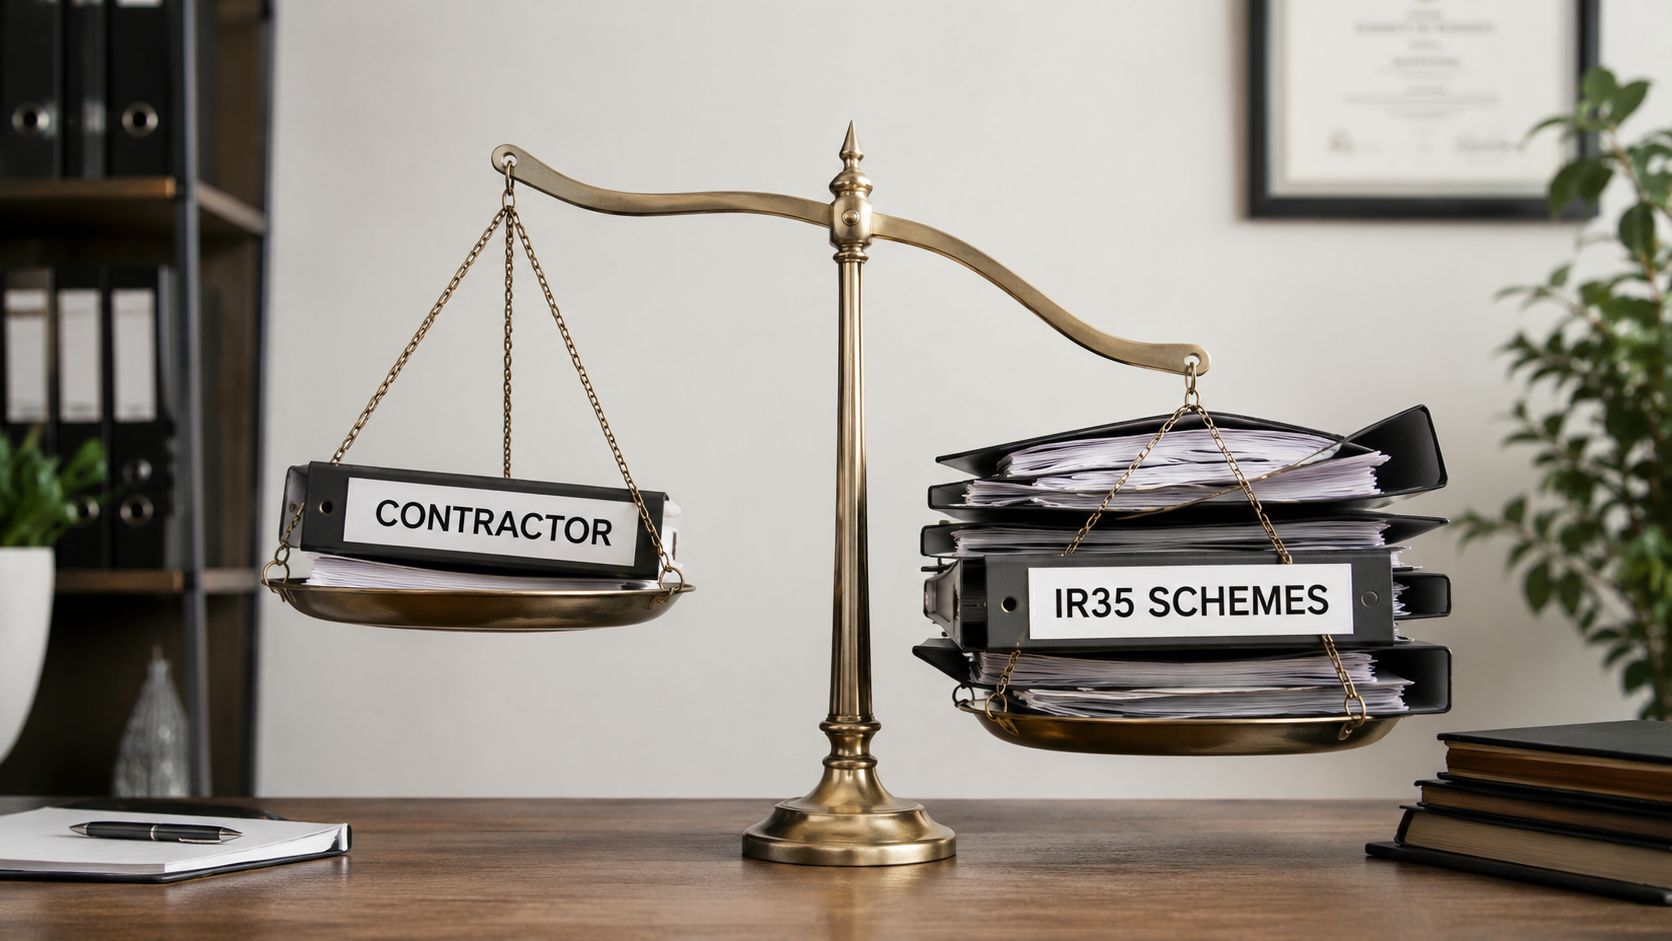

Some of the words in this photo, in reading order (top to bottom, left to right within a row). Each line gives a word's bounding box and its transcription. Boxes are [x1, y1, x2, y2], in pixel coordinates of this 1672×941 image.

[375, 499, 612, 546] CONTRACTOR
[1056, 588, 1134, 618] IR35
[1149, 585, 1328, 617] SCHEMES
